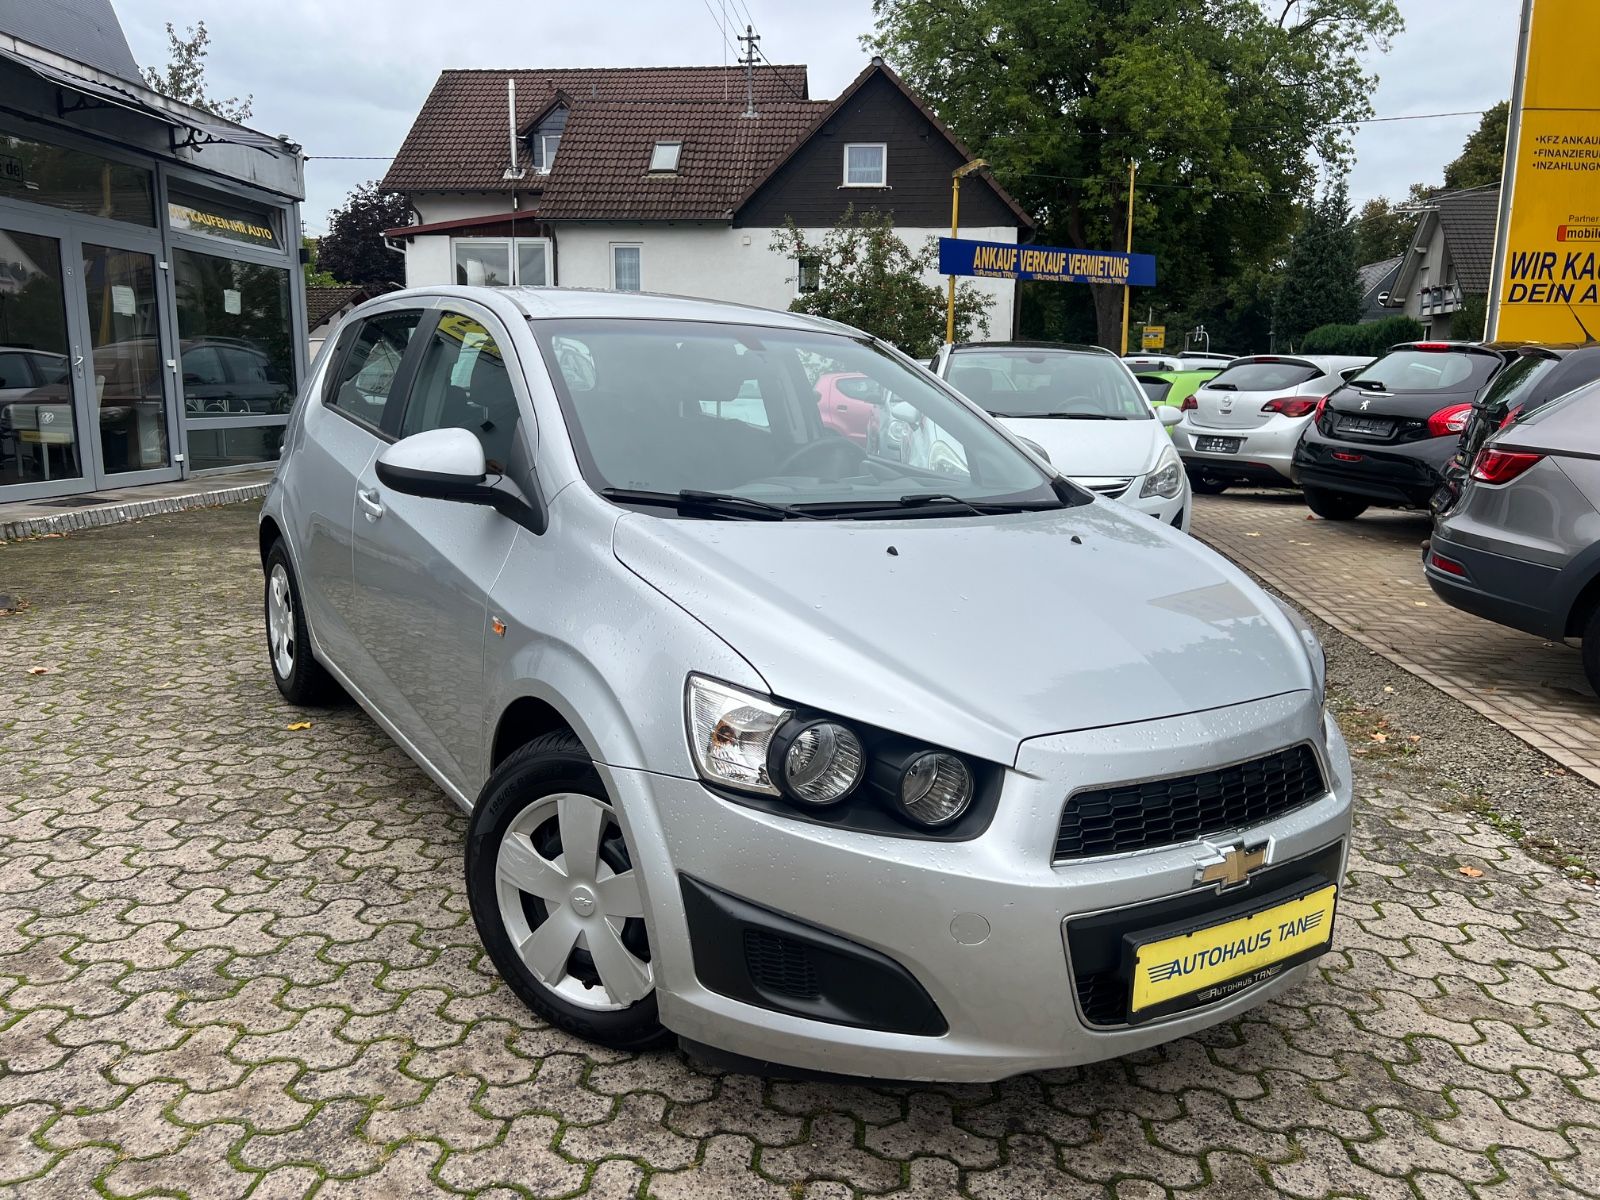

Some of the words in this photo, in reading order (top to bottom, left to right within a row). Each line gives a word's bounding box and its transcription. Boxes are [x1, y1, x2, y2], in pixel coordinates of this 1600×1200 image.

[1539, 135, 1560, 144] KFZ
[1562, 135, 1600, 145] ANKAU
[1538, 148, 1600, 159] FINANZIERU
[189, 210, 231, 230] KAUFEN
[230, 219, 247, 233] IHR
[248, 225, 273, 240] AUTO
[1568, 214, 1600, 223] Partner
[973, 245, 1018, 271] ANKAUF
[1020, 249, 1067, 274] VERKAUF
[1068, 253, 1130, 278] VERMIETUNG
[1510, 251, 1557, 280] WIR
[1561, 251, 1600, 281] KA
[1507, 283, 1576, 303] DEIN
[1168, 929, 1272, 980] AUTOHAUS
[1278, 915, 1309, 942] TAN
[1253, 968, 1274, 982] TAN
